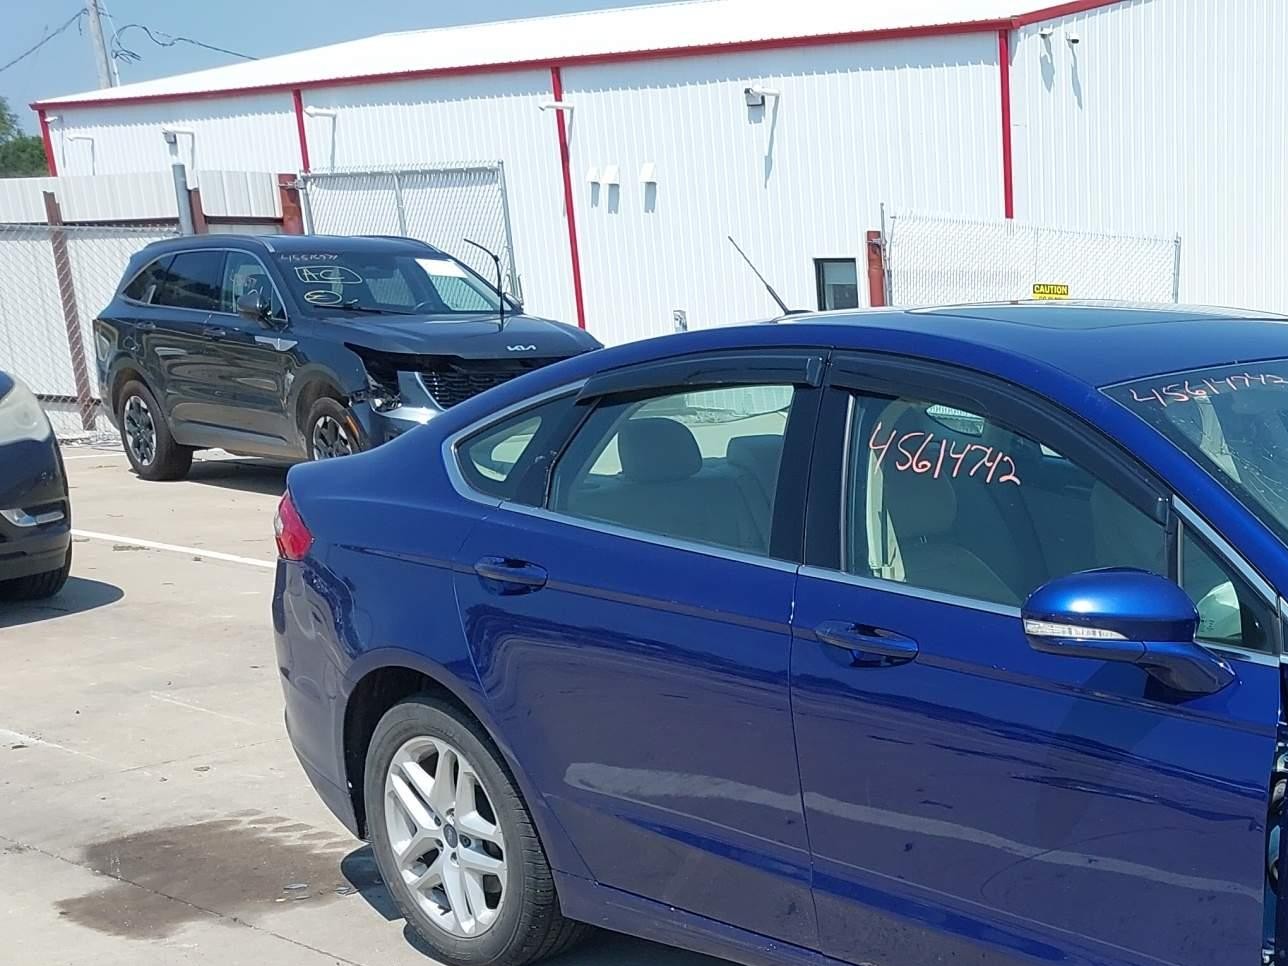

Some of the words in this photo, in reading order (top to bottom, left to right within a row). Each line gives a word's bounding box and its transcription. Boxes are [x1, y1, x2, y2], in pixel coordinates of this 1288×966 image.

[303, 267, 344, 282] AC
[1034, 285, 1068, 294] CAUTION
[869, 421, 1021, 486] 45614742
